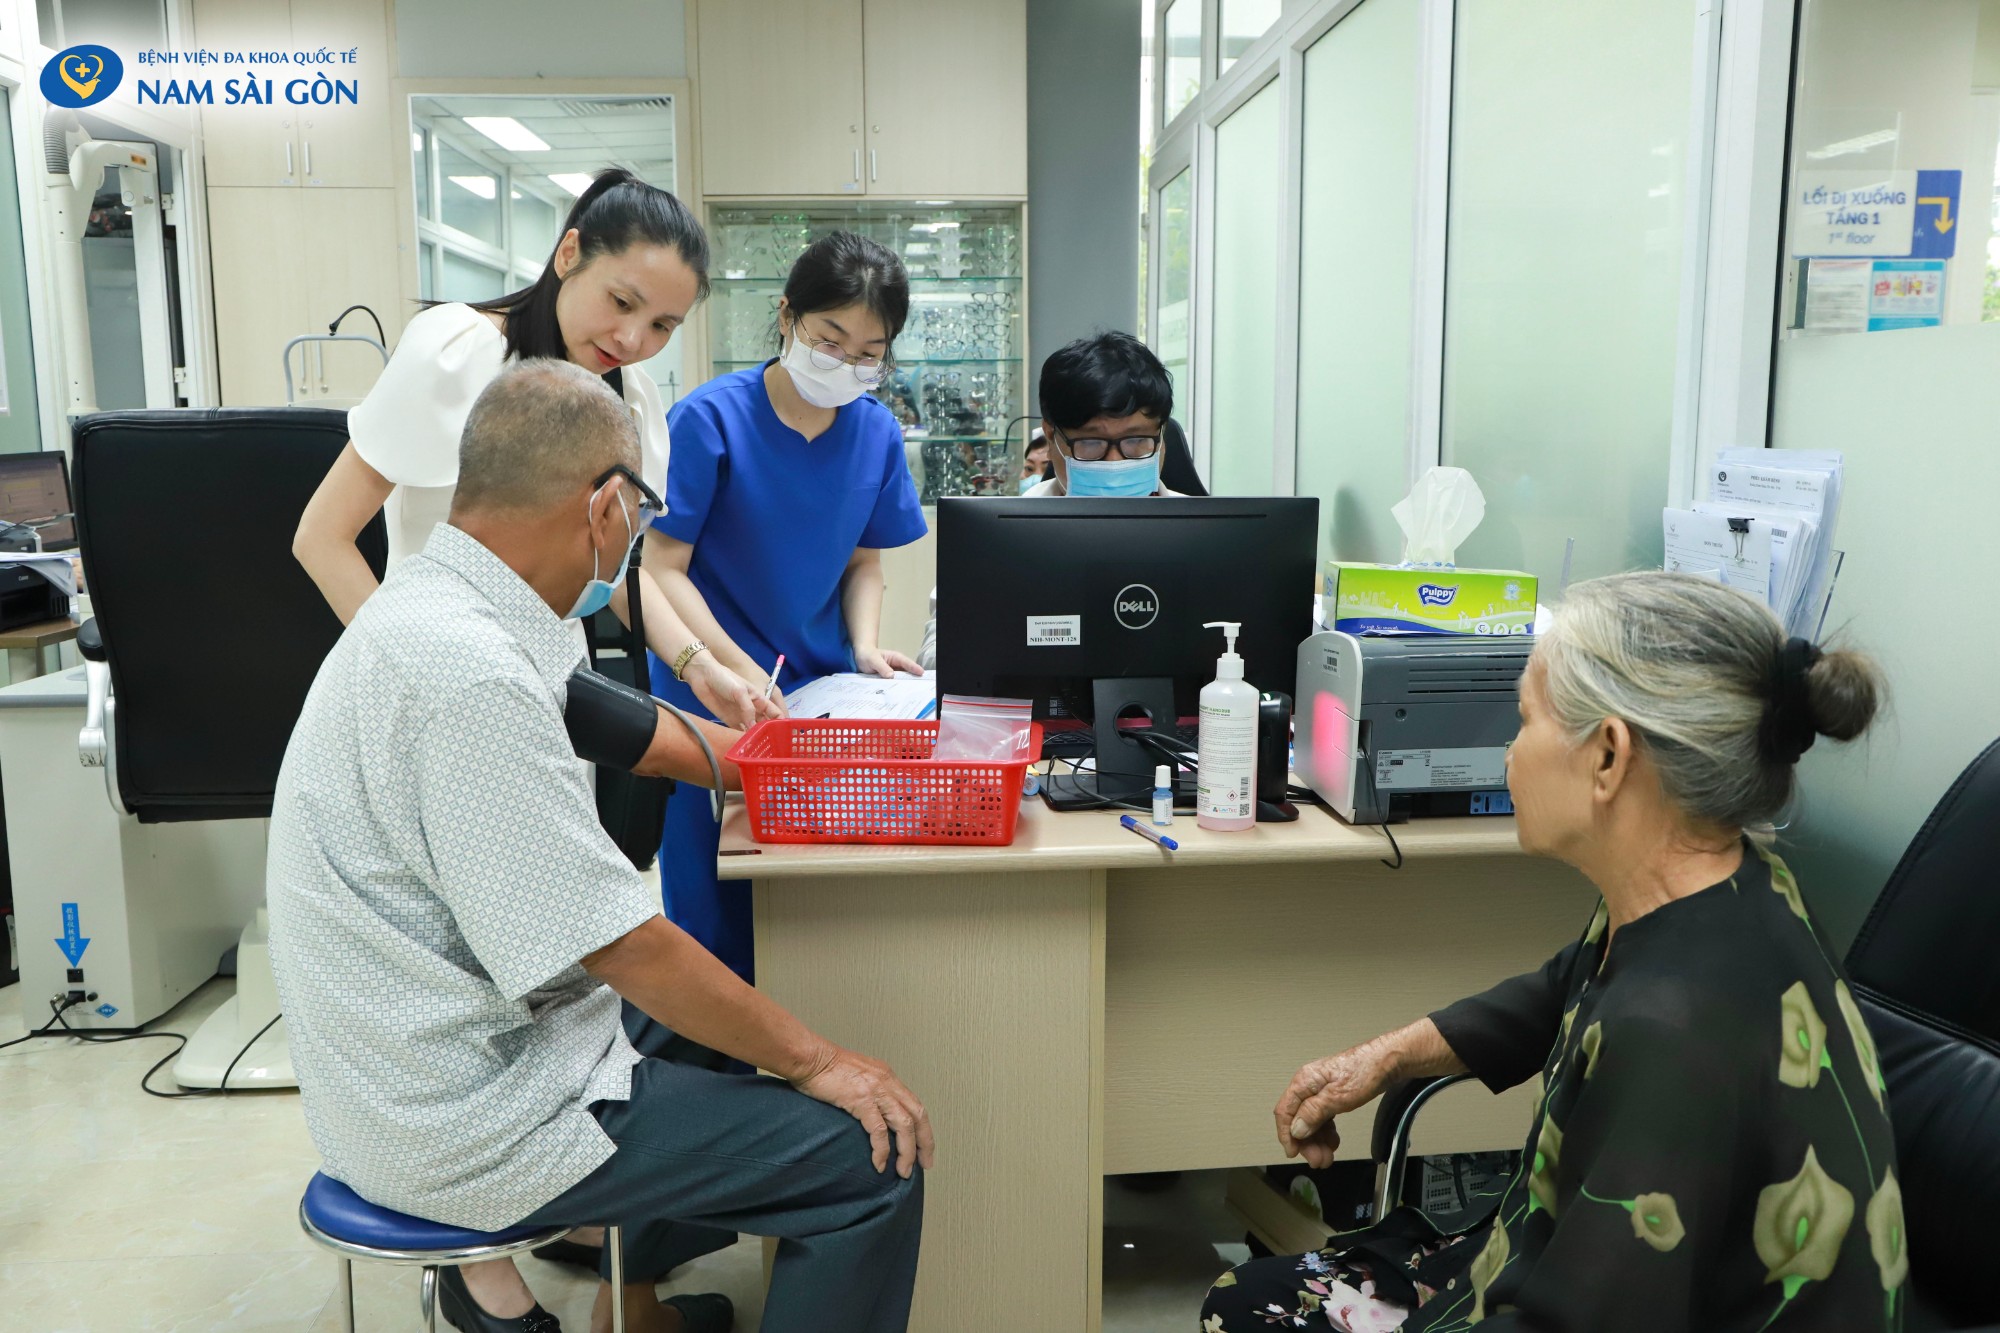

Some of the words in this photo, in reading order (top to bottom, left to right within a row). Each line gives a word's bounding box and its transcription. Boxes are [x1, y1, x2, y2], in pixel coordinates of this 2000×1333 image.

[1802, 185, 1828, 205] LỐI
[1831, 192, 1847, 205] ĐI
[1851, 185, 1907, 205] XUỐNG
[1872, 211, 1881, 225] 1
[1845, 231, 1876, 244] floor
[1422, 587, 1455, 600] Pulppy
[1119, 600, 1155, 613] DELL
